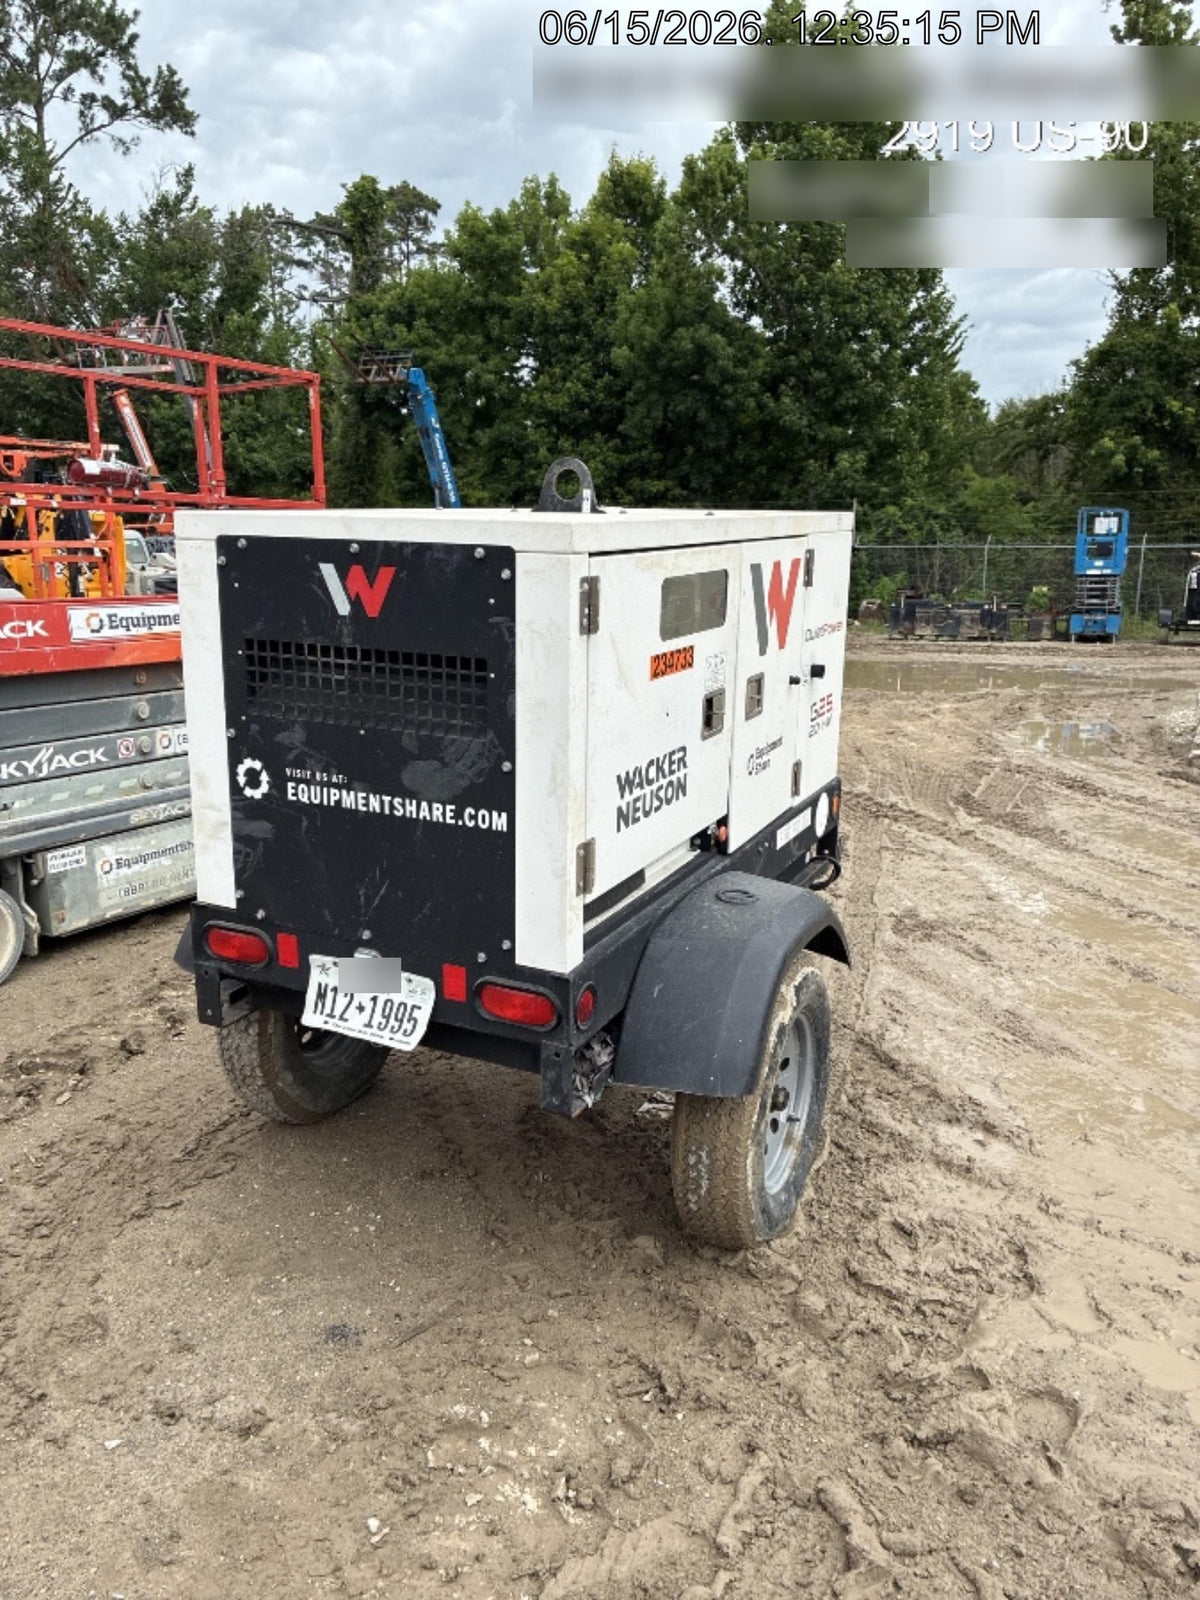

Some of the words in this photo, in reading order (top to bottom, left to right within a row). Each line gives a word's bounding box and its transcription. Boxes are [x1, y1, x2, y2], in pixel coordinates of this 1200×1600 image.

[285, 767, 312, 780] VISIT
[315, 771, 328, 782] US
[331, 775, 348, 785] AT:
[616, 745, 688, 800] WACKER
[287, 781, 508, 833] EQUIPMENTSHARE.COM
[616, 772, 687, 833] NEUSON
